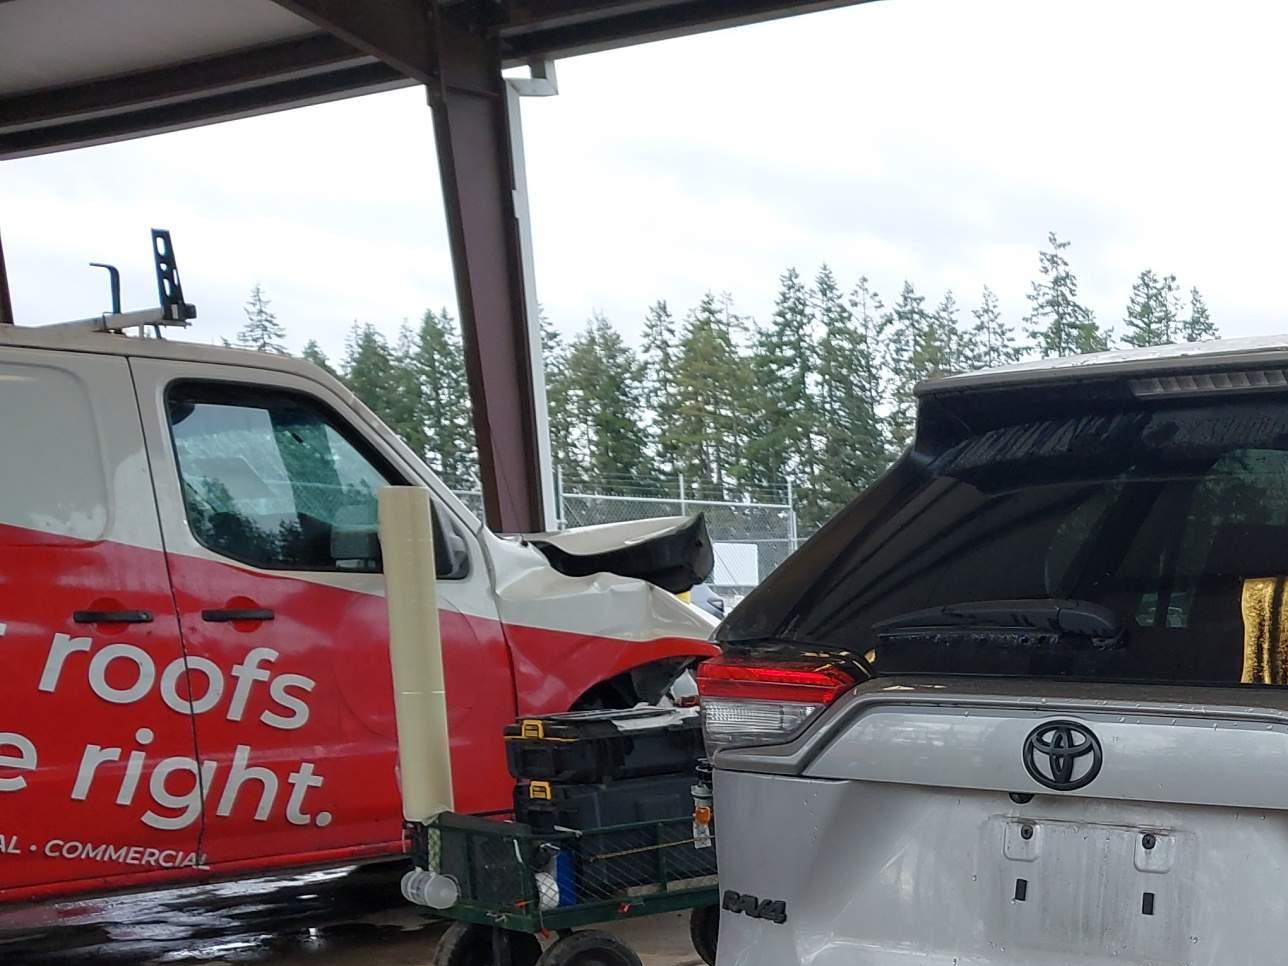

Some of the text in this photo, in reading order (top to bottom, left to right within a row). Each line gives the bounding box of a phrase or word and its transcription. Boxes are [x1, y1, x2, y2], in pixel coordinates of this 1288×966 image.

[38, 632, 317, 730] roofs
[70, 728, 333, 830] right.
[45, 839, 211, 870] COMMERCIAL
[722, 890, 787, 924] RAV4
